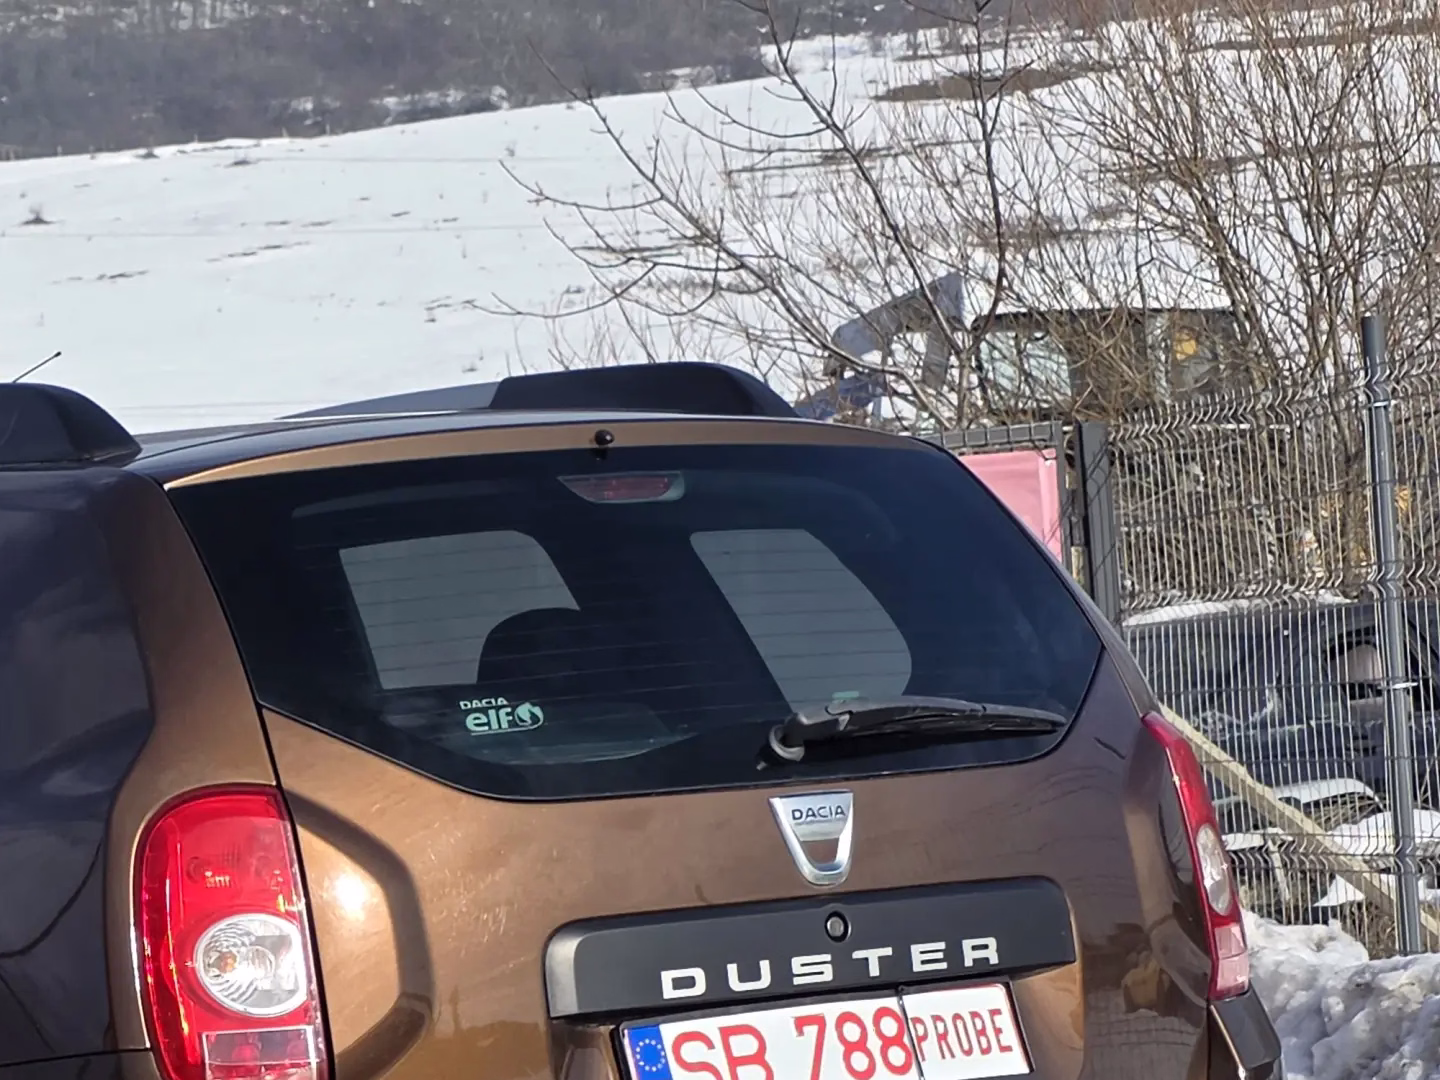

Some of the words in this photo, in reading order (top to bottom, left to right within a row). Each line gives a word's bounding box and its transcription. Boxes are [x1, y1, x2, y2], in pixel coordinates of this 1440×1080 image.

[459, 697, 509, 710] DACIA
[465, 707, 513, 732] elf
[791, 805, 846, 820] DACIA
[661, 936, 1000, 999] DUSTER
[911, 1008, 1013, 1062] PROBE
